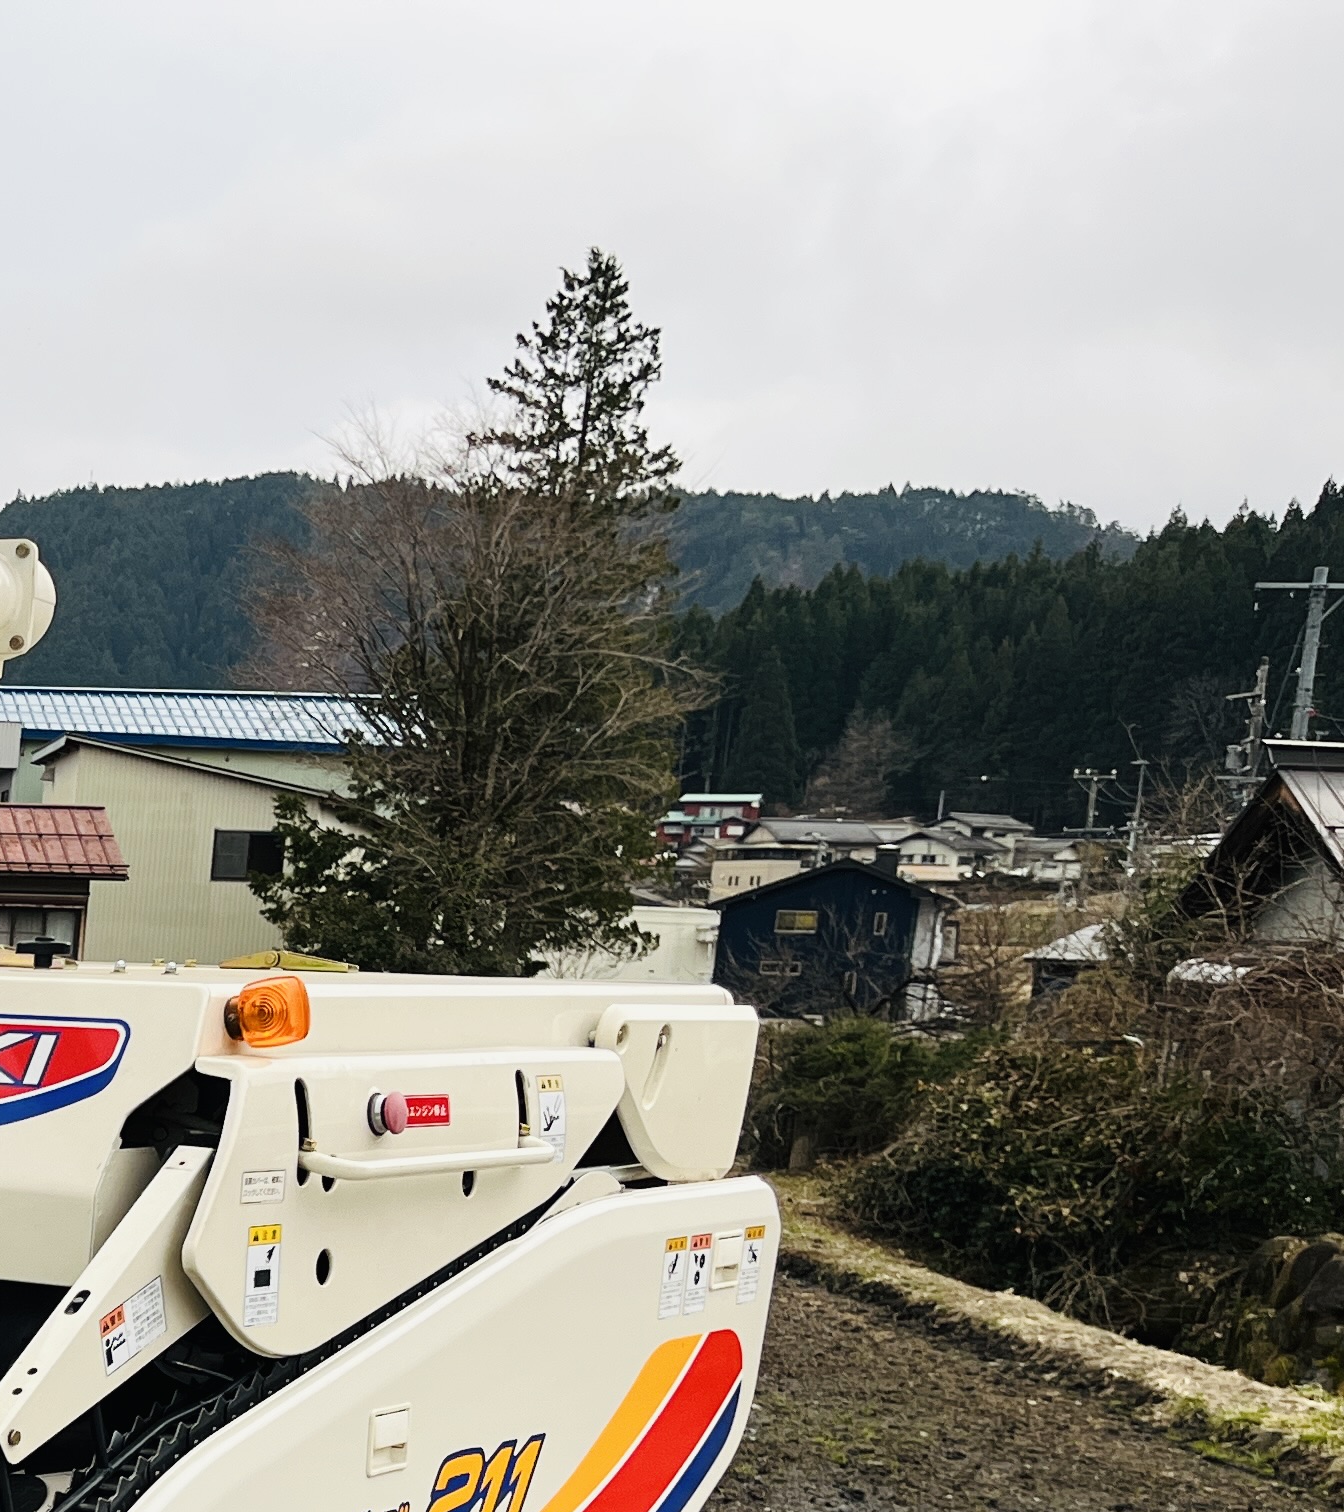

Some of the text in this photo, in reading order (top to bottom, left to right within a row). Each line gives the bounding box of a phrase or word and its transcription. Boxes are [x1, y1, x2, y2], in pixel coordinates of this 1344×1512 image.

[406, 1105, 448, 1118] エンジン停止
